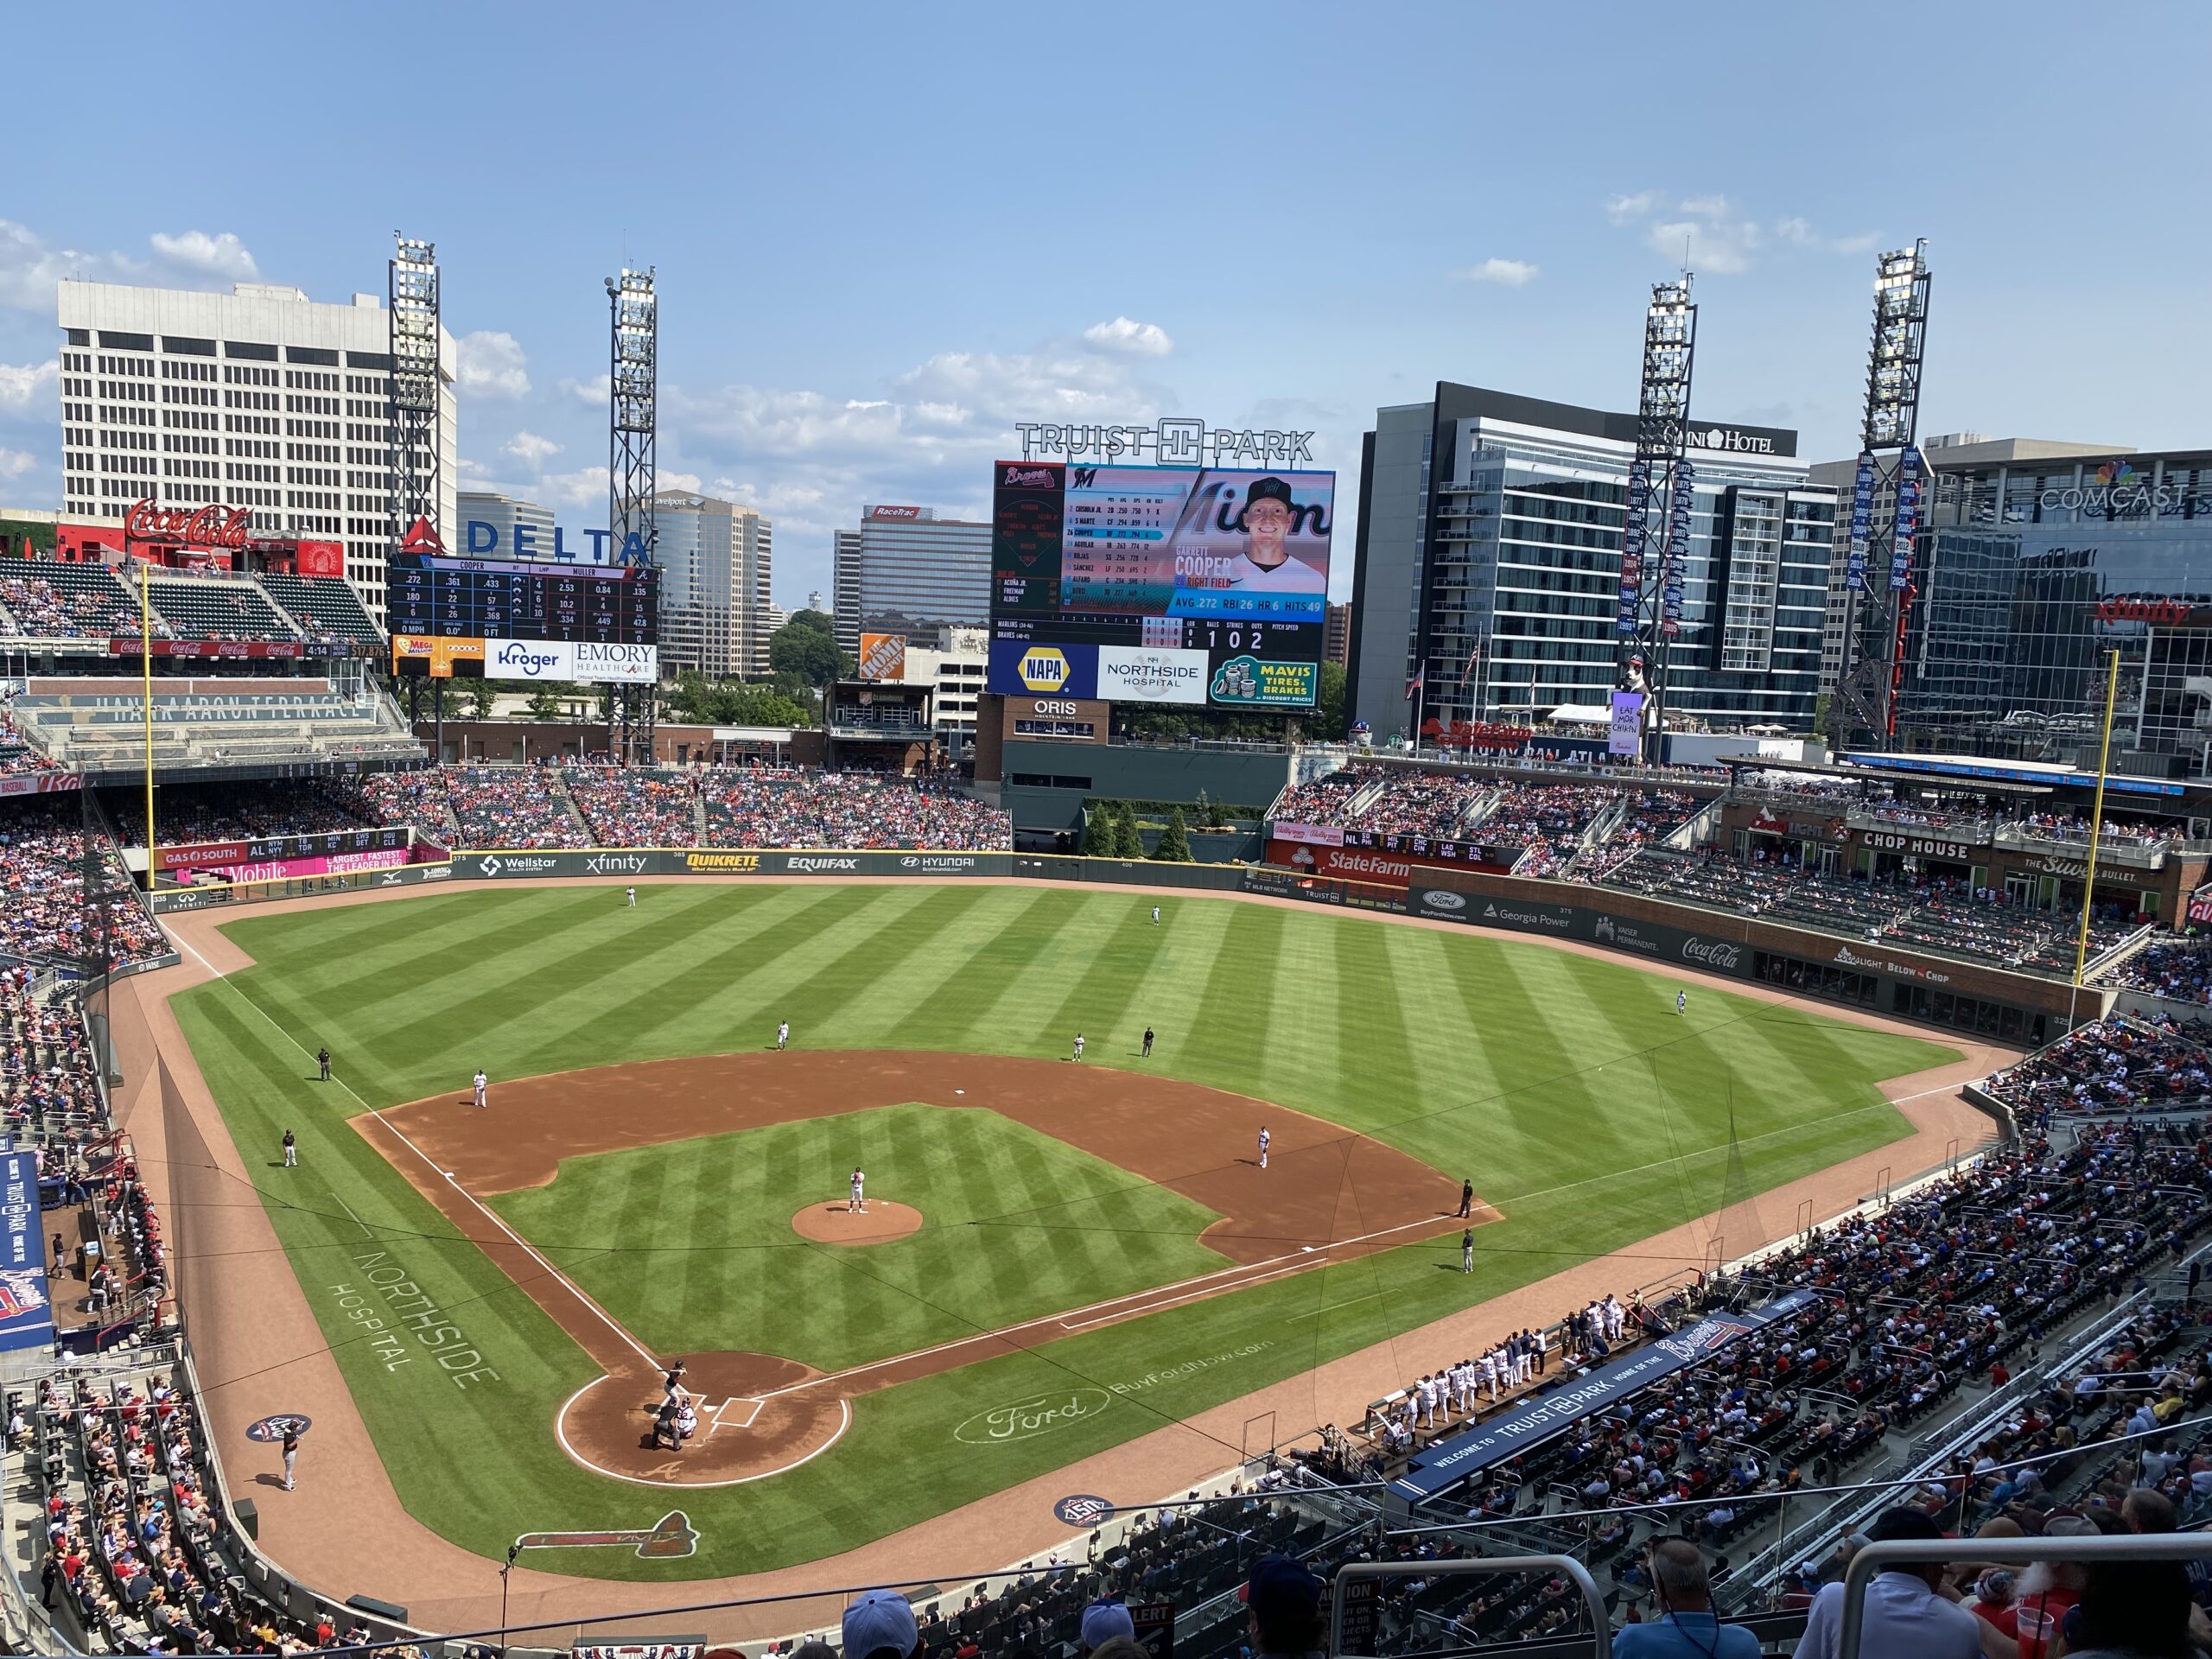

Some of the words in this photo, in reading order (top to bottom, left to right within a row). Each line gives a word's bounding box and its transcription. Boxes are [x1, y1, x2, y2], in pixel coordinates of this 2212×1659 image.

[1015, 423, 1149, 455] TRUIST
[1214, 429, 1314, 461] PARK
[1724, 430, 1775, 454] HOTEL
[1005, 467, 1046, 486] Braves
[2040, 484, 2190, 510] COMCAST
[876, 507, 915, 517] RaceTrac
[124, 498, 255, 547] Coca-Cola
[467, 520, 649, 563] DELTA
[1176, 546, 1209, 556] GARRETT
[460, 562, 485, 570] COOPER
[1175, 556, 1231, 576] COOPER
[406, 575, 421, 584] .272
[446, 577, 461, 586] .361
[1187, 577, 1209, 588] RIGHT
[1211, 577, 1231, 588] FIELD
[406, 593, 420, 601] 180
[595, 586, 611, 594] 0.84
[560, 600, 575, 608] 10.2
[1175, 598, 1195, 607] AVG
[1196, 598, 1217, 608] .272
[1224, 600, 1239, 609] RBI
[1241, 600, 1253, 610] 26
[1258, 601, 1271, 610] HR
[1272, 601, 1279, 611] 6
[1286, 601, 1306, 612] HITS
[1308, 601, 1321, 612] 49
[2094, 594, 2193, 626] xfinity
[485, 612, 500, 620] .368
[633, 619, 647, 627] 47.8
[410, 639, 433, 649] MEGA
[1210, 630, 1216, 647] 1
[1229, 631, 1241, 648] 0
[1251, 632, 1262, 649] 2
[170, 642, 202, 654] Coca-Cola
[218, 643, 249, 655] Coca-Cola
[267, 645, 296, 656] Coca-Cola
[308, 646, 327, 656] 4:14
[352, 646, 385, 657] $17,876
[577, 643, 653, 663] EMORY
[866, 639, 883, 657] THE
[499, 643, 559, 676] Kroger
[861, 636, 904, 678] HOME
[577, 664, 650, 674] HEALTHCARE
[878, 652, 906, 679] DEPOT
[1027, 658, 1063, 681] NAPA
[1108, 664, 1199, 678] NORTHSIDE
[1260, 665, 1311, 677] MAVIS
[1123, 677, 1181, 688] HOSPITAL
[1265, 677, 1300, 686] TIRES
[1263, 686, 1307, 696] BRAKES
[169, 696, 258, 721] AARON
[251, 696, 361, 720] TERRACE
[1034, 700, 1077, 715] ORIS
[1619, 707, 1633, 715] EAT
[1618, 715, 1634, 724] MOR
[1612, 723, 1637, 734] CHIKIN
[2, 781, 28, 793] BASEBALL
[1345, 835, 1358, 844] NL
[1865, 833, 1906, 849] CHOP
[1911, 840, 1968, 859] HOUSE
[166, 854, 189, 864] GAS
[202, 849, 238, 861] SOUTH
[251, 843, 265, 856] AL
[327, 854, 365, 865] LARGEST.
[368, 851, 402, 861] FASTEST.
[505, 857, 557, 869] Wellstar
[587, 854, 647, 874] xfinity
[686, 854, 760, 867] QUIKRETE
[788, 857, 857, 872] EQUIFAX
[923, 857, 975, 867] HYUNDAI
[2025, 859, 2041, 868] THE
[232, 862, 287, 883] Mobile
[327, 864, 341, 873] THE
[344, 862, 380, 871] LEADER
[1306, 890, 1329, 899] TRUIST
[1431, 893, 1458, 907] Ford
[169, 901, 207, 910] INFINITI
[1421, 909, 1466, 920] BuyFordNow.com
[1500, 909, 1536, 925] Georgia
[1540, 914, 1570, 928] Power
[1618, 926, 1638, 936] KAISER
[1618, 935, 1658, 951] PERMANENTE
[1682, 937, 1742, 969] Coca-Cola
[1859, 959, 1883, 969] LIGHT
[2054, 1016, 2070, 1026] 325
[7, 1181, 25, 1205] TRUIST
[9, 1212, 27, 1234] PARK
[327, 1282, 411, 1372] HOSPITAL
[353, 1251, 501, 1389] NORTHSIDE
[1108, 1338, 1274, 1395] BuyFordNow.com
[1433, 1442, 1484, 1469] WELCOME
[1483, 1437, 1496, 1446] TO
[1494, 1408, 1556, 1438] TRUIST
[1569, 1380, 1616, 1403] PARK
[1612, 1368, 1639, 1382] HOME
[1637, 1362, 1647, 1370] OF
[1647, 1355, 1663, 1367] THE
[1655, 1319, 1721, 1362] Braves
[987, 1396, 1087, 1438] Ford
[1133, 1607, 1169, 1623] LERT
